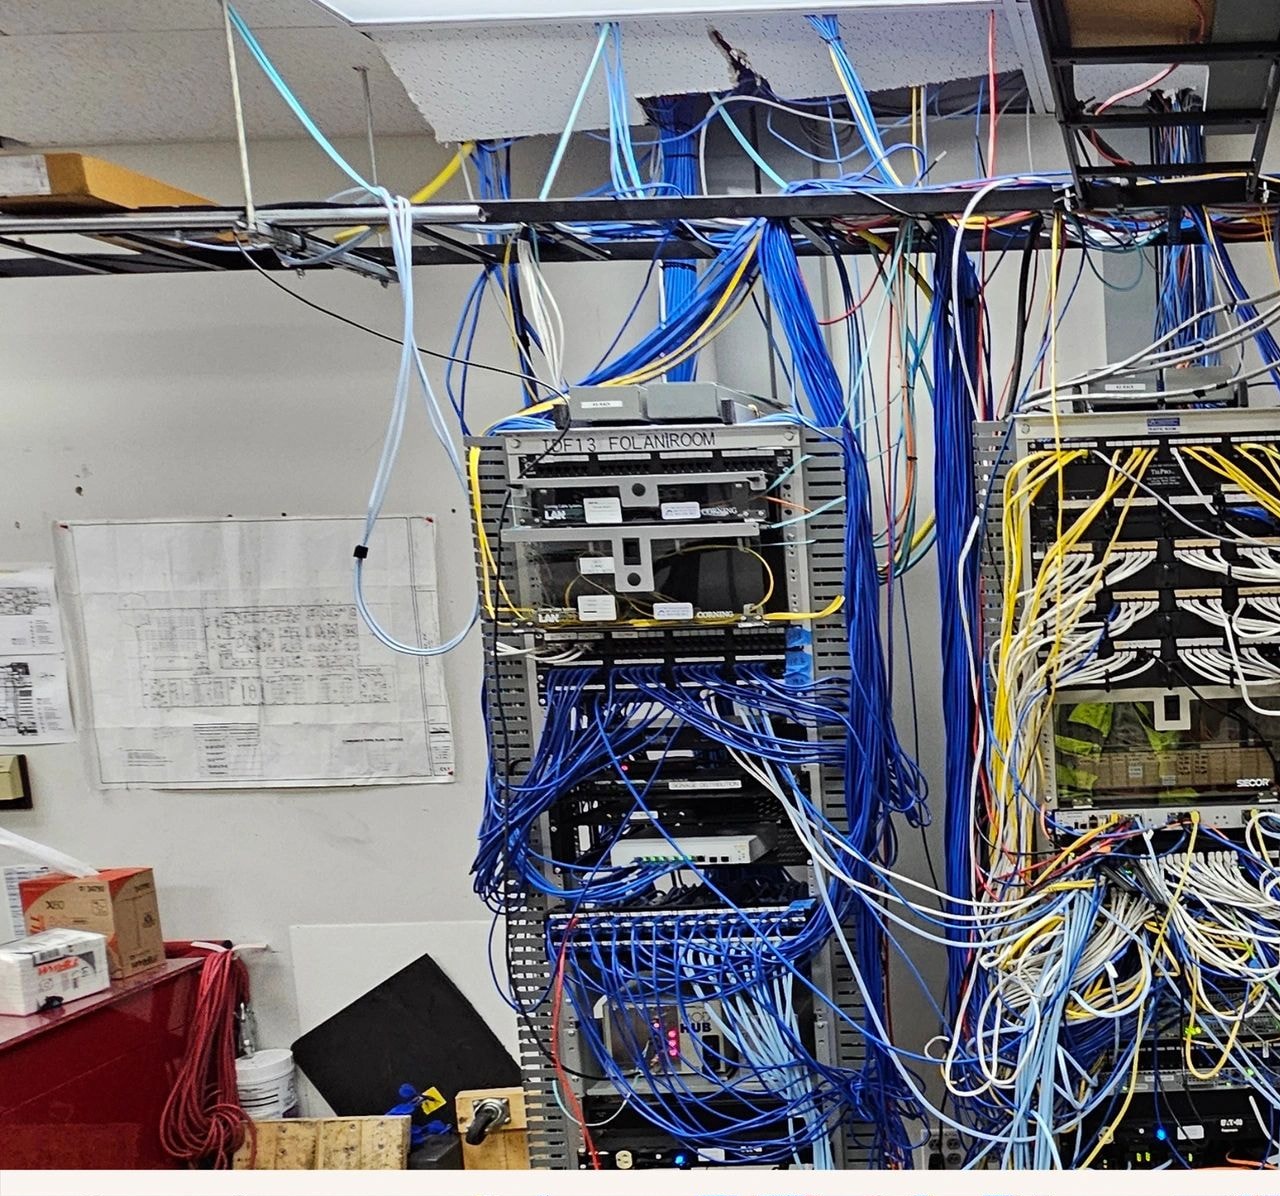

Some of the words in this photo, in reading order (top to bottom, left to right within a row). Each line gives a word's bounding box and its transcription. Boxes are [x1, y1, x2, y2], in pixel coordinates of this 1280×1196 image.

[542, 437, 596, 453] IDF13
[544, 510, 567, 520] LAN
[538, 613, 560, 623] LAN
[696, 610, 734, 619] CORNING
[680, 1022, 712, 1033] HUB
